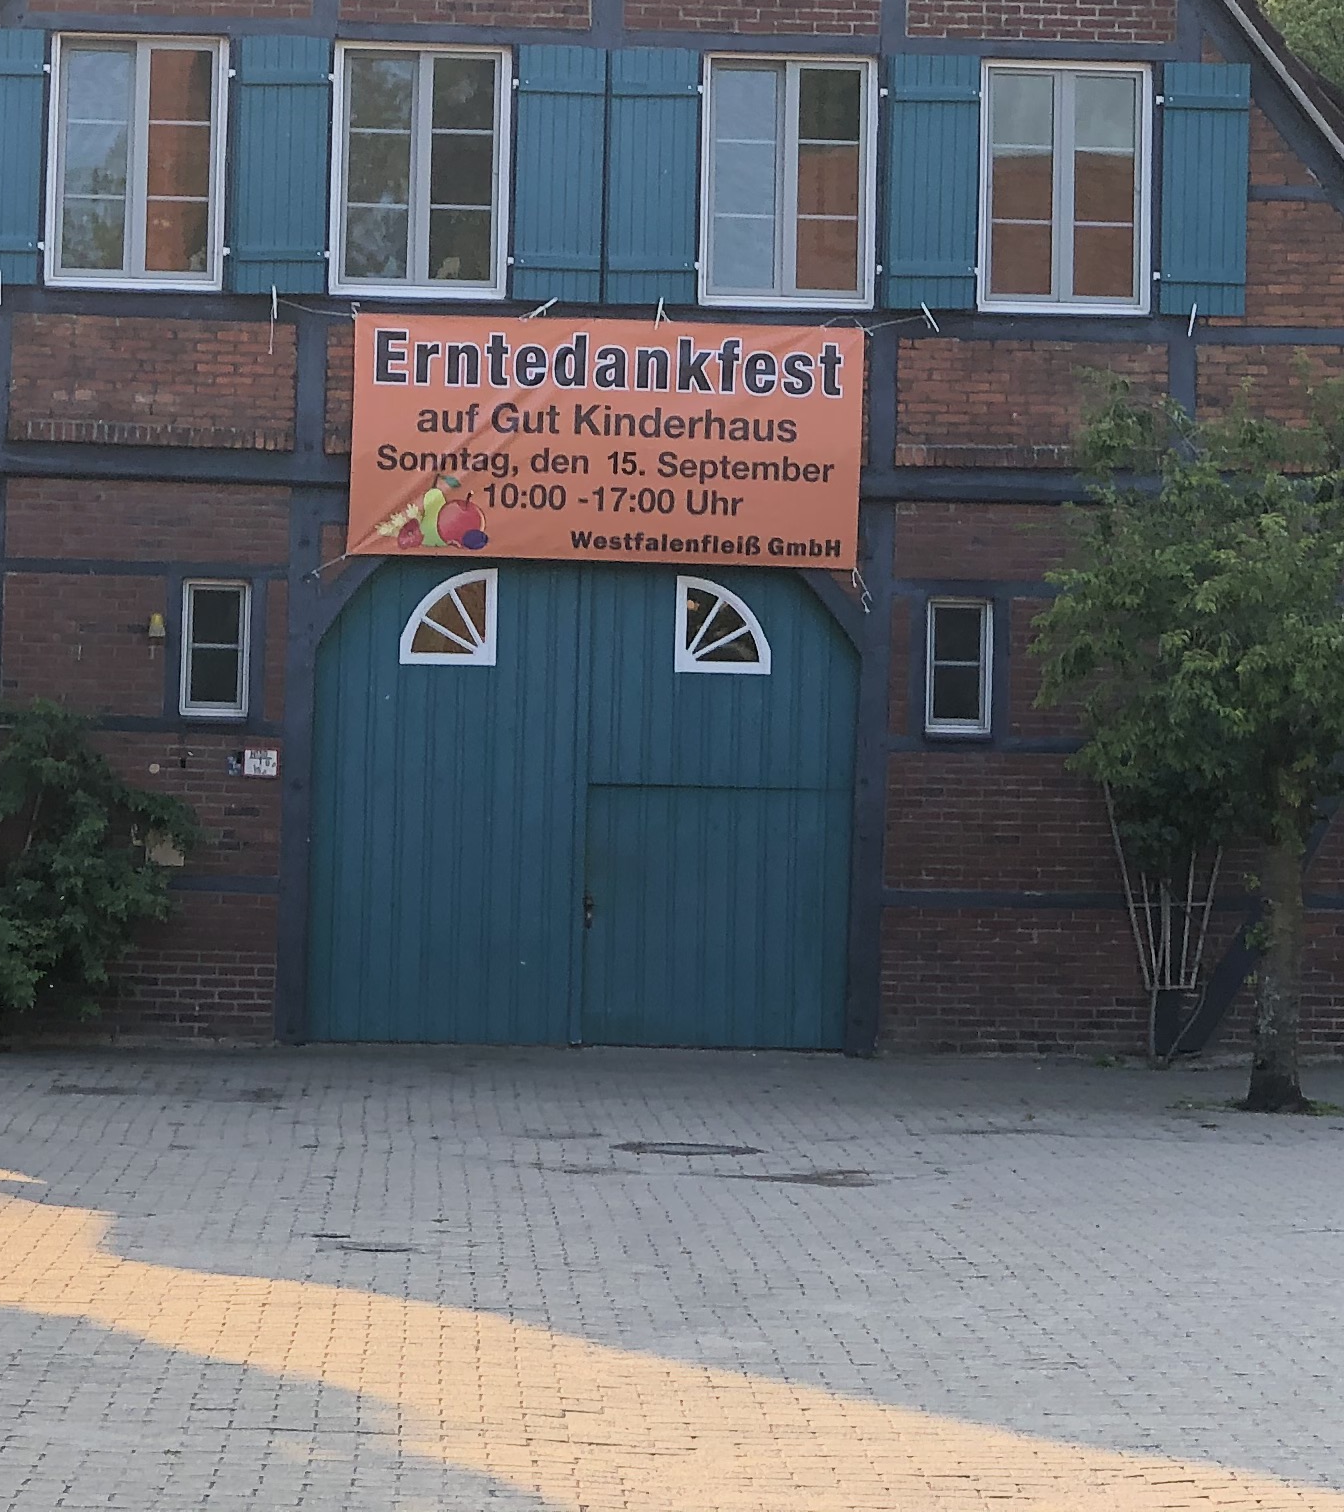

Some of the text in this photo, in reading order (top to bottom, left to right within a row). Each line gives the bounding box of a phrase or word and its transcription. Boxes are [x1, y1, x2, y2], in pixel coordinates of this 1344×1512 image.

[373, 327, 844, 399] Erntedankfest
[417, 402, 798, 444] auf Gut Kinderhaus
[376, 444, 835, 484] Sonntag, den 15. September
[484, 483, 567, 510] 10:00
[686, 489, 744, 516] Uhr
[571, 530, 842, 558] Westfalenfleiß GmbH
